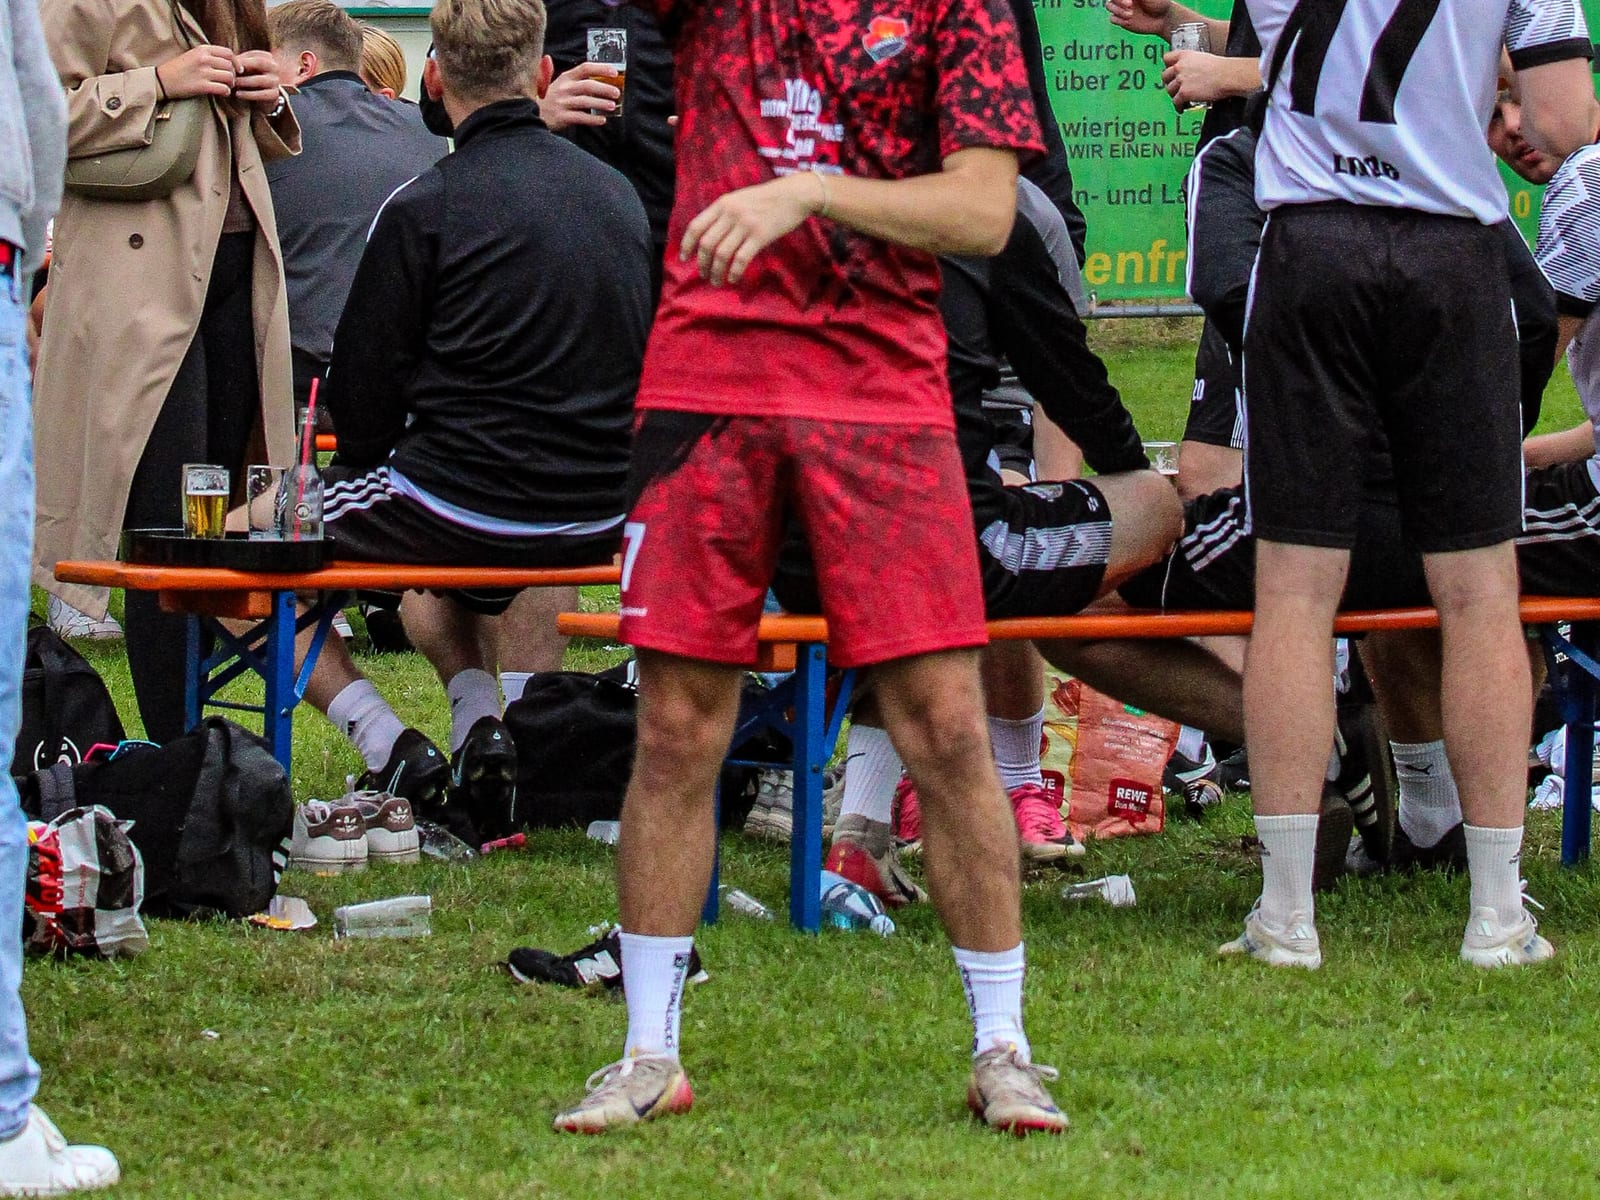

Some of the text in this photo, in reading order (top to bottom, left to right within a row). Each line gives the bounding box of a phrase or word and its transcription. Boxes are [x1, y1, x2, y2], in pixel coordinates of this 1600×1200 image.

[1043, 44, 1055, 60] e
[1064, 40, 1134, 61] durch
[1056, 69, 1109, 91] über
[1118, 70, 1145, 90] 20
[1062, 116, 1166, 142] wierigen
[1069, 143, 1195, 158] WIR EINEN NE
[1107, 183, 1152, 205] und
[621, 522, 646, 592] 7
[1116, 786, 1148, 804] REWE
